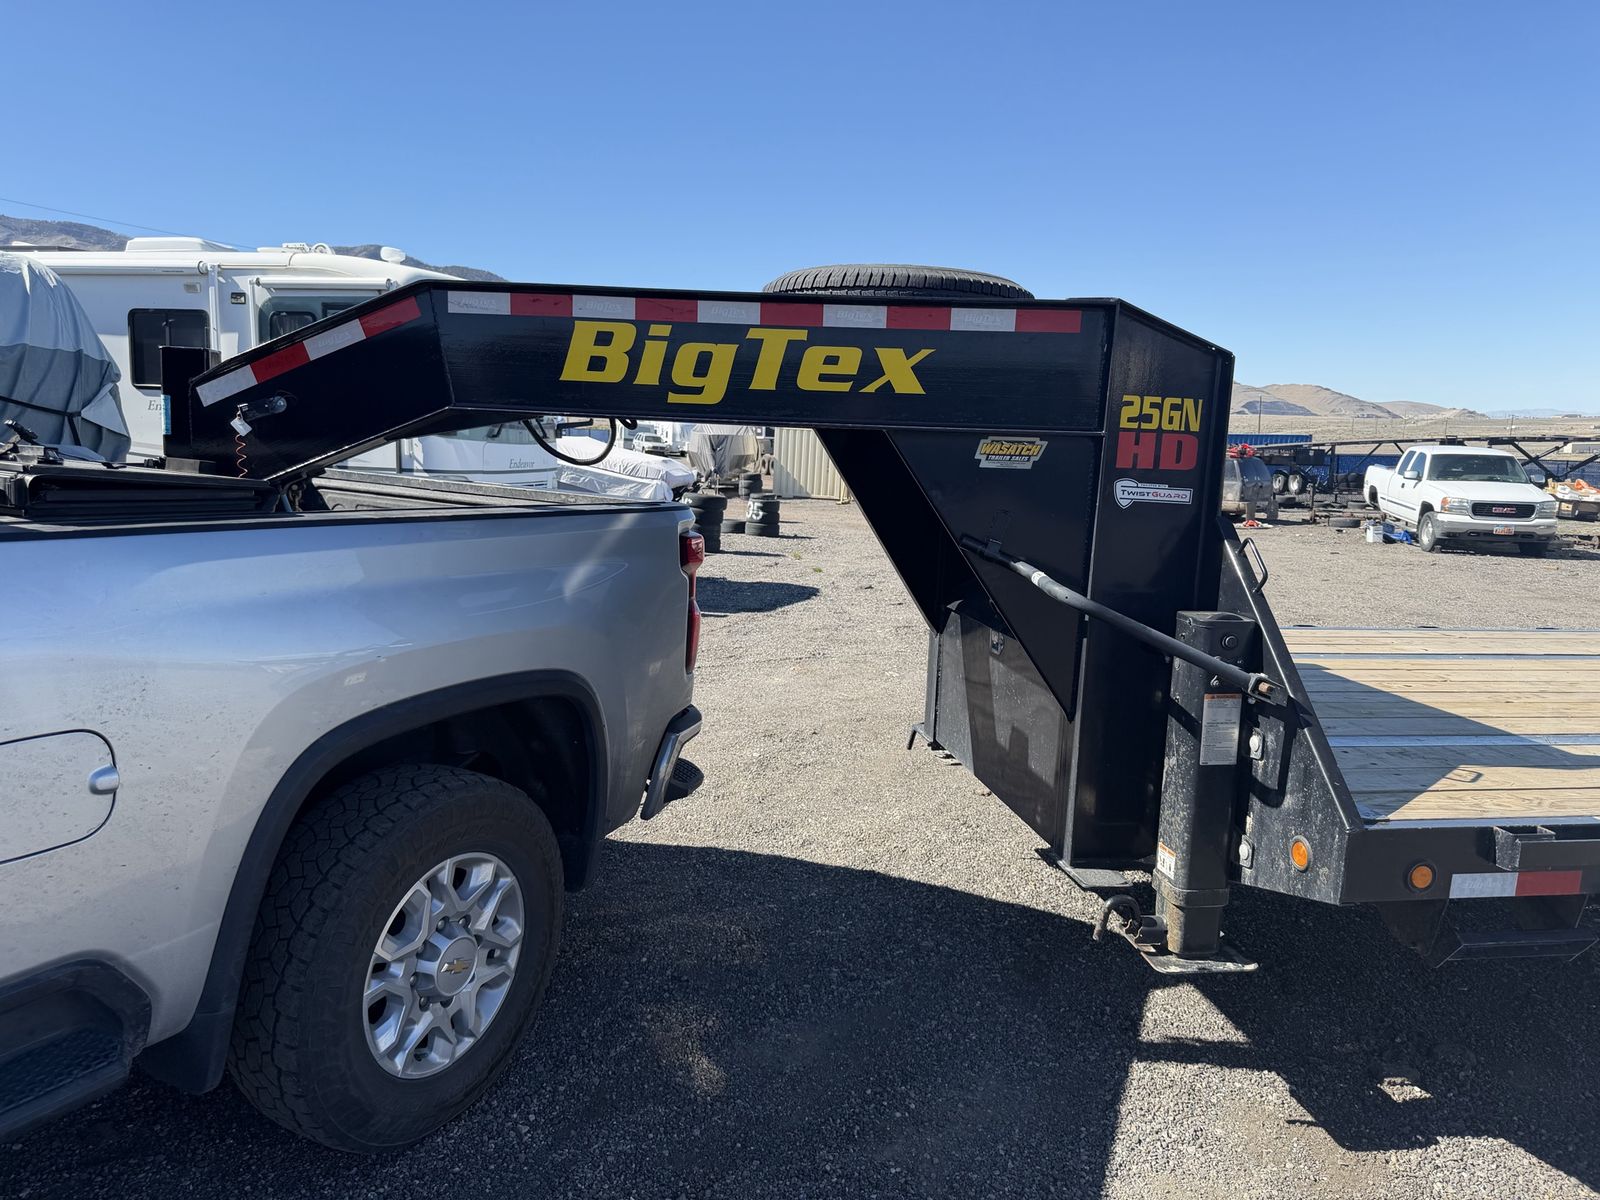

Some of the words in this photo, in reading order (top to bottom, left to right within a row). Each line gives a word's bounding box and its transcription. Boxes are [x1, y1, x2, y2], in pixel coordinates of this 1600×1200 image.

[559, 320, 937, 404] BigTex
[1119, 394, 1203, 432] 25GN
[980, 443, 1042, 456] WASATCH
[1115, 431, 1199, 471] HD
